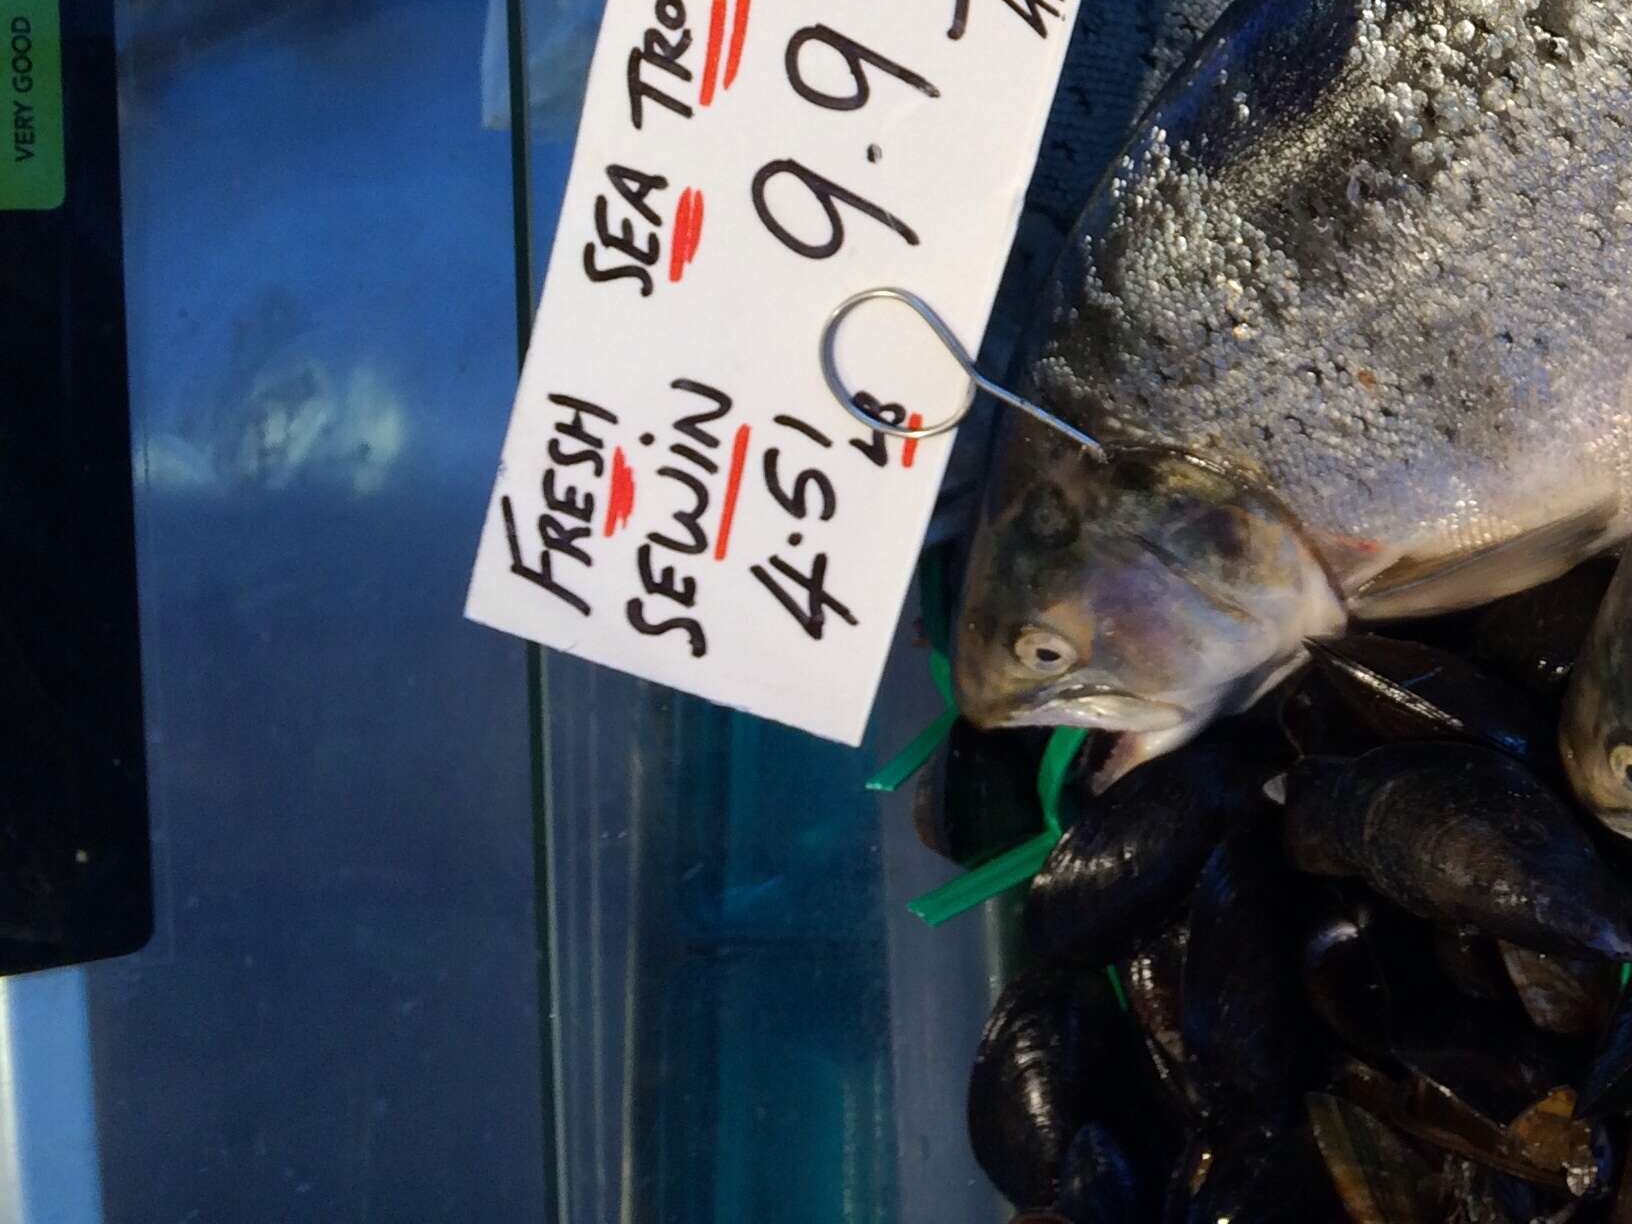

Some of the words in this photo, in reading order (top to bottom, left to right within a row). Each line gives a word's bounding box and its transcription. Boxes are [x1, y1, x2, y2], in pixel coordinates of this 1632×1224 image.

[11, 15, 33, 94] GOOD
[14, 100, 36, 163] VERY
[501, 393, 618, 617] FRESH
[583, 164, 668, 297] SEA
